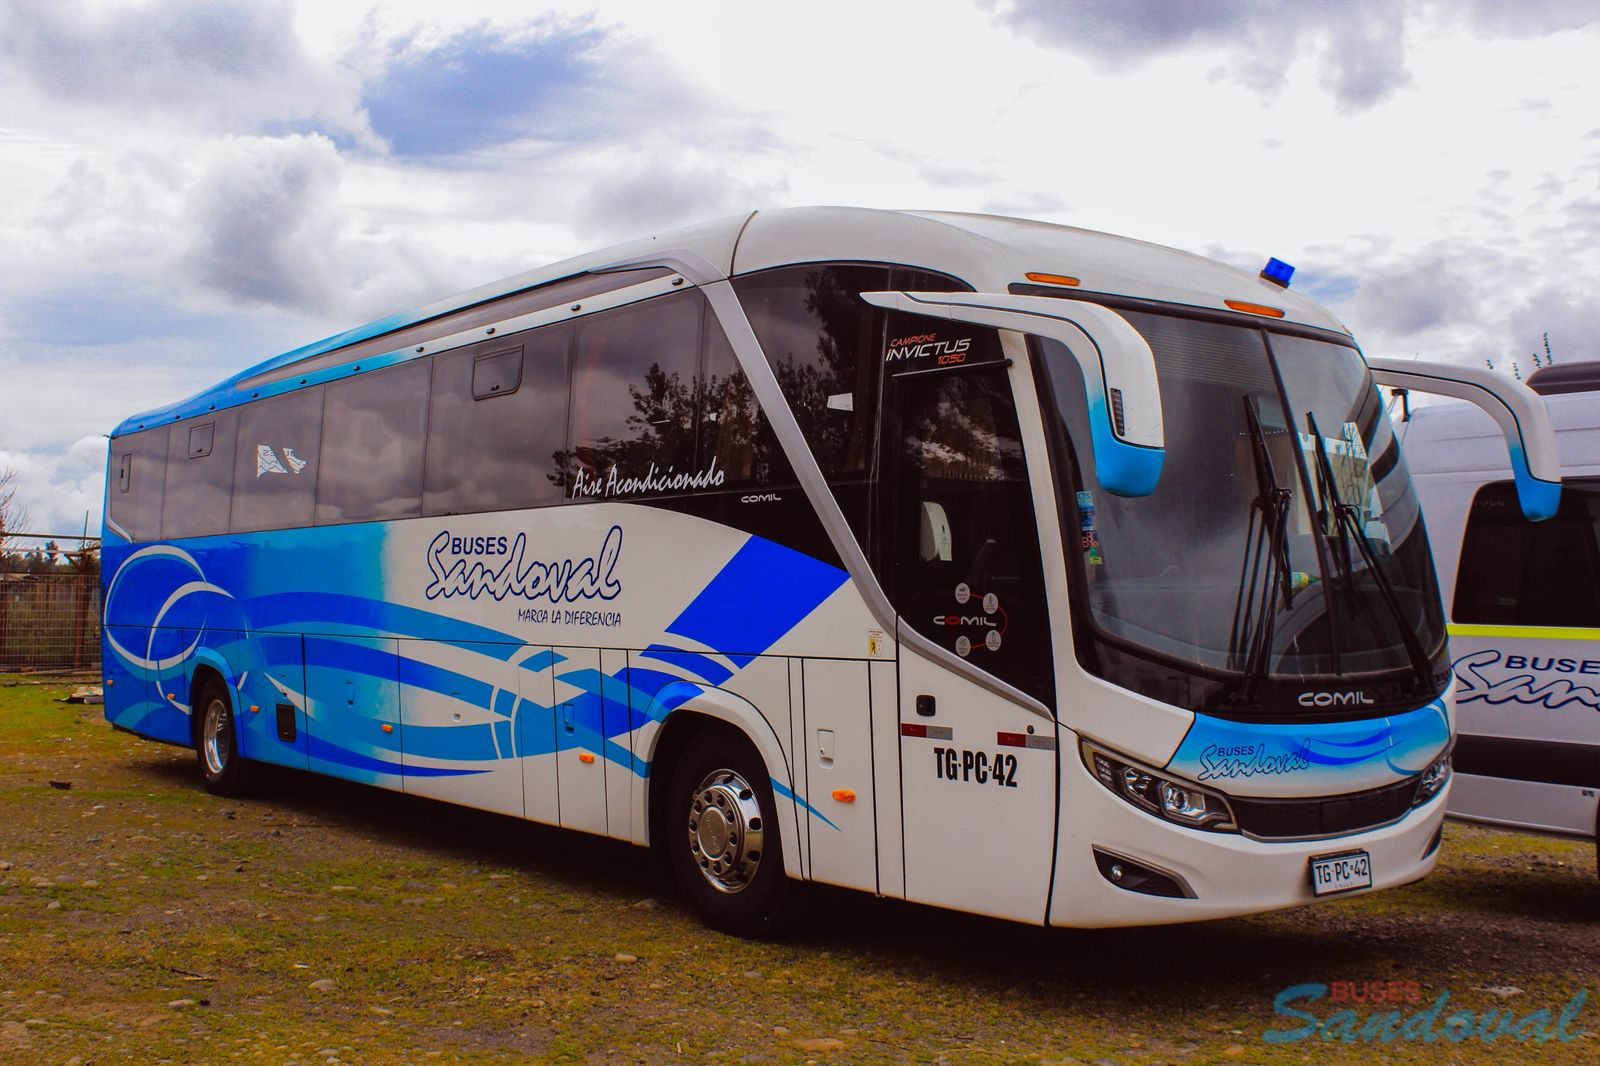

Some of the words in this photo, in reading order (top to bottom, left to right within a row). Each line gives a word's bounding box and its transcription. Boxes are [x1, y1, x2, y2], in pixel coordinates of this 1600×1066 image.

[885, 338, 971, 361] INVICTUS
[890, 333, 937, 347] CAMPIONE
[937, 353, 967, 365] 1050
[572, 466, 602, 499] Aire
[605, 456, 725, 497] Acondicionado
[741, 493, 782, 503] COMIL
[451, 536, 508, 555] BUSES
[425, 524, 623, 603] Sandoval
[518, 608, 548, 624] MARCA
[551, 610, 561, 624] LA
[564, 610, 622, 627] DIFERENCIA
[933, 615, 997, 627] COMIL
[1452, 649, 1600, 713] San
[1297, 691, 1374, 707] COMIL
[1197, 738, 1311, 780] Sandoval
[1217, 745, 1255, 757] BUSES
